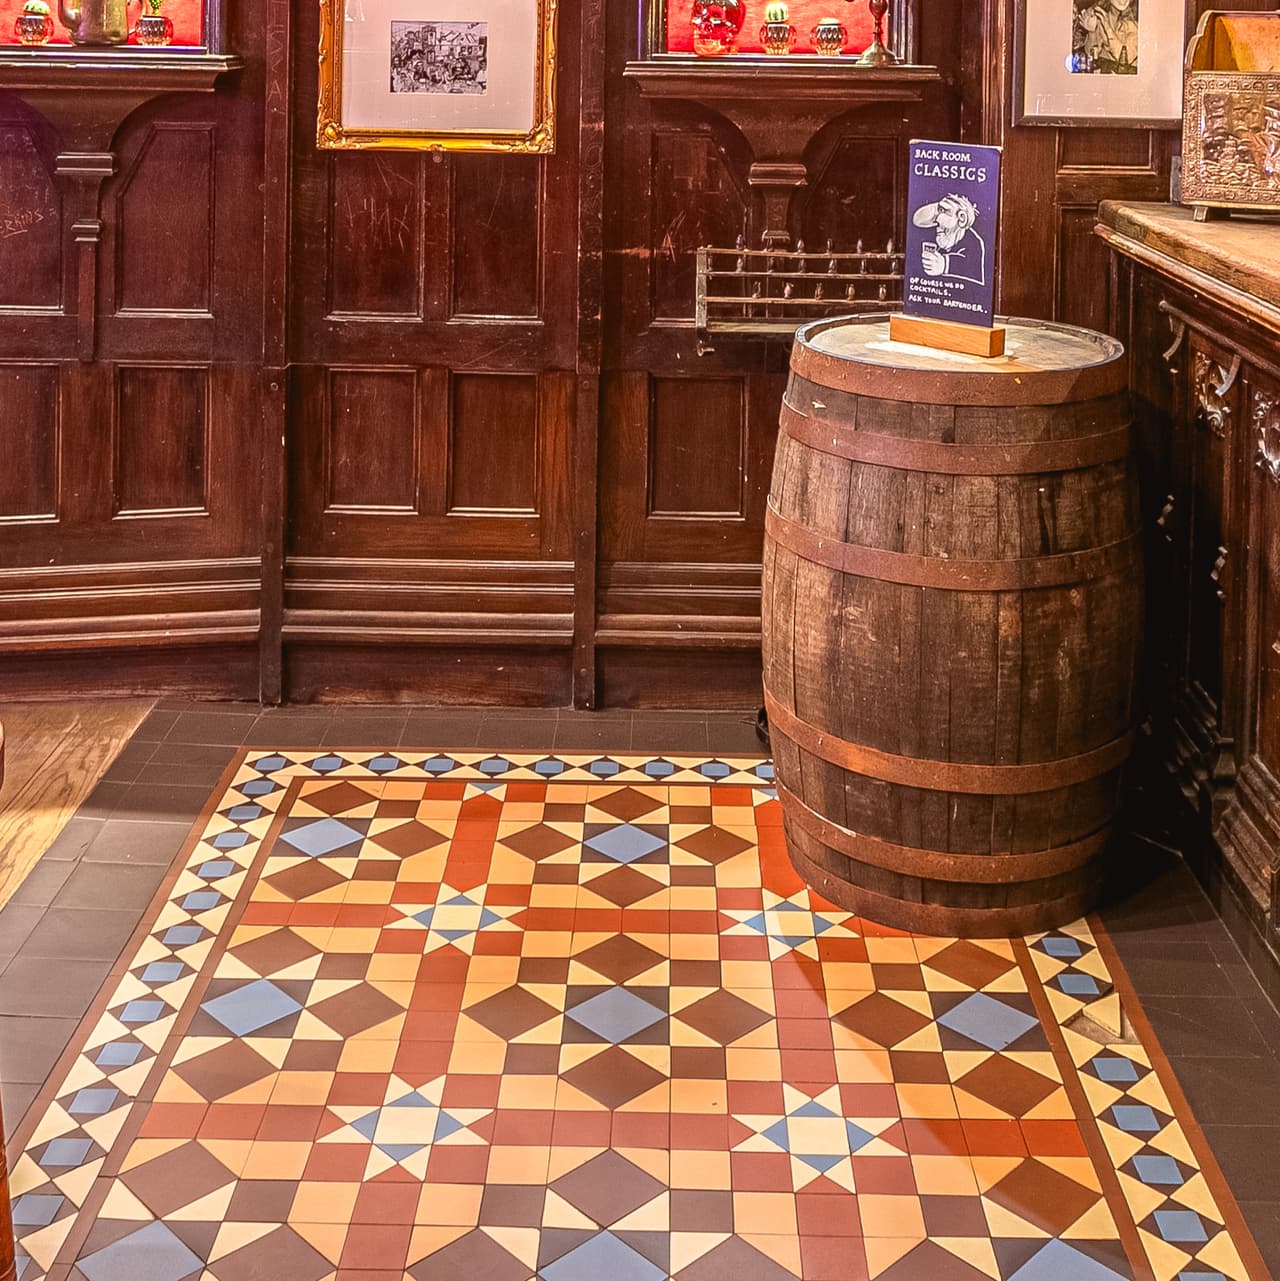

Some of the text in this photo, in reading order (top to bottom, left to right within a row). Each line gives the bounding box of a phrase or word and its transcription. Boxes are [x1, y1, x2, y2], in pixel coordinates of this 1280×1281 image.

[914, 149, 972, 162] BACK ROOM
[914, 163, 987, 183] CLASSICS
[920, 278, 944, 288] COURSE
[909, 285, 952, 297] COCKTAILS.
[908, 294, 988, 314] ASK YOUR BARTENDER.
